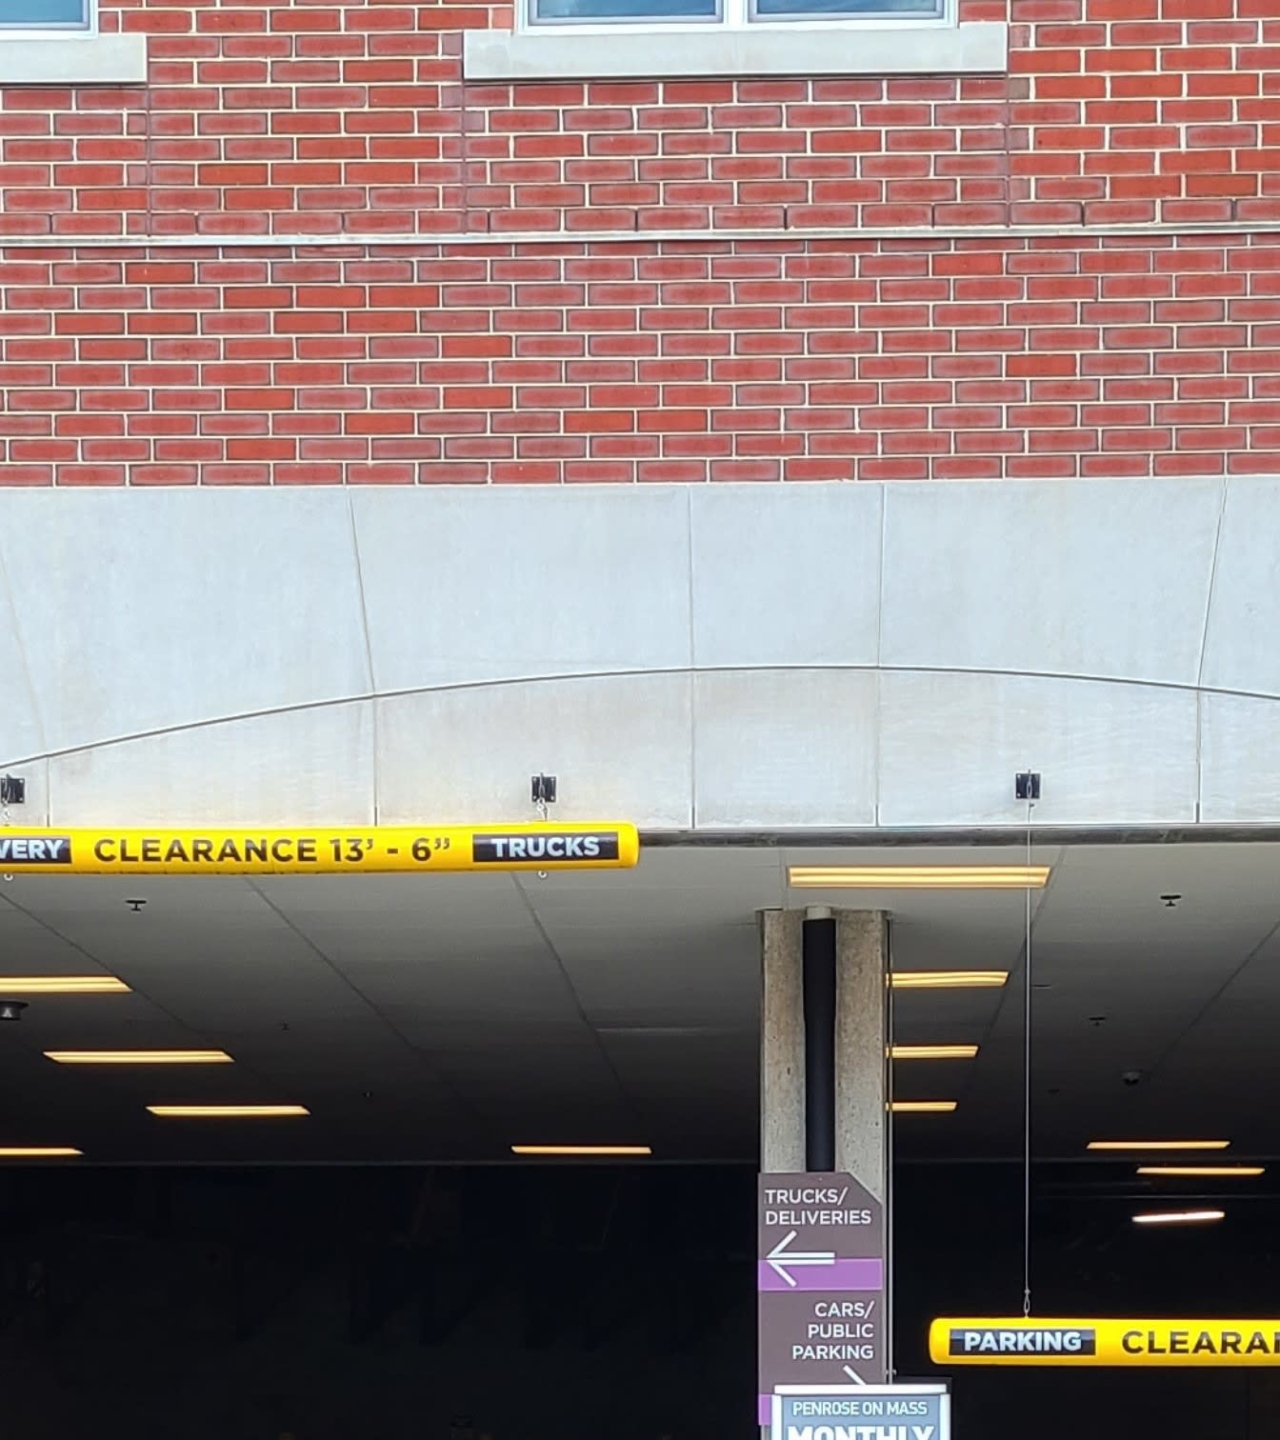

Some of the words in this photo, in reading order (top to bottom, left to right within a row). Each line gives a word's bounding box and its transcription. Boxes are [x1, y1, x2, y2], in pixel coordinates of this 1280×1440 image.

[94, 837, 318, 863] CLEARANCE
[491, 835, 601, 858] TRUCKS
[764, 1187, 848, 1205] TRUCKS/
[765, 1210, 871, 1225] DELIVERIES
[814, 1301, 875, 1318] CARS/
[808, 1324, 874, 1339] PUBLIC
[964, 1332, 1082, 1352] PARKING
[792, 1346, 874, 1361] PARKING
[792, 1402, 859, 1416] PENROSE
[862, 1402, 883, 1416] ON
[886, 1402, 928, 1416] MASS
